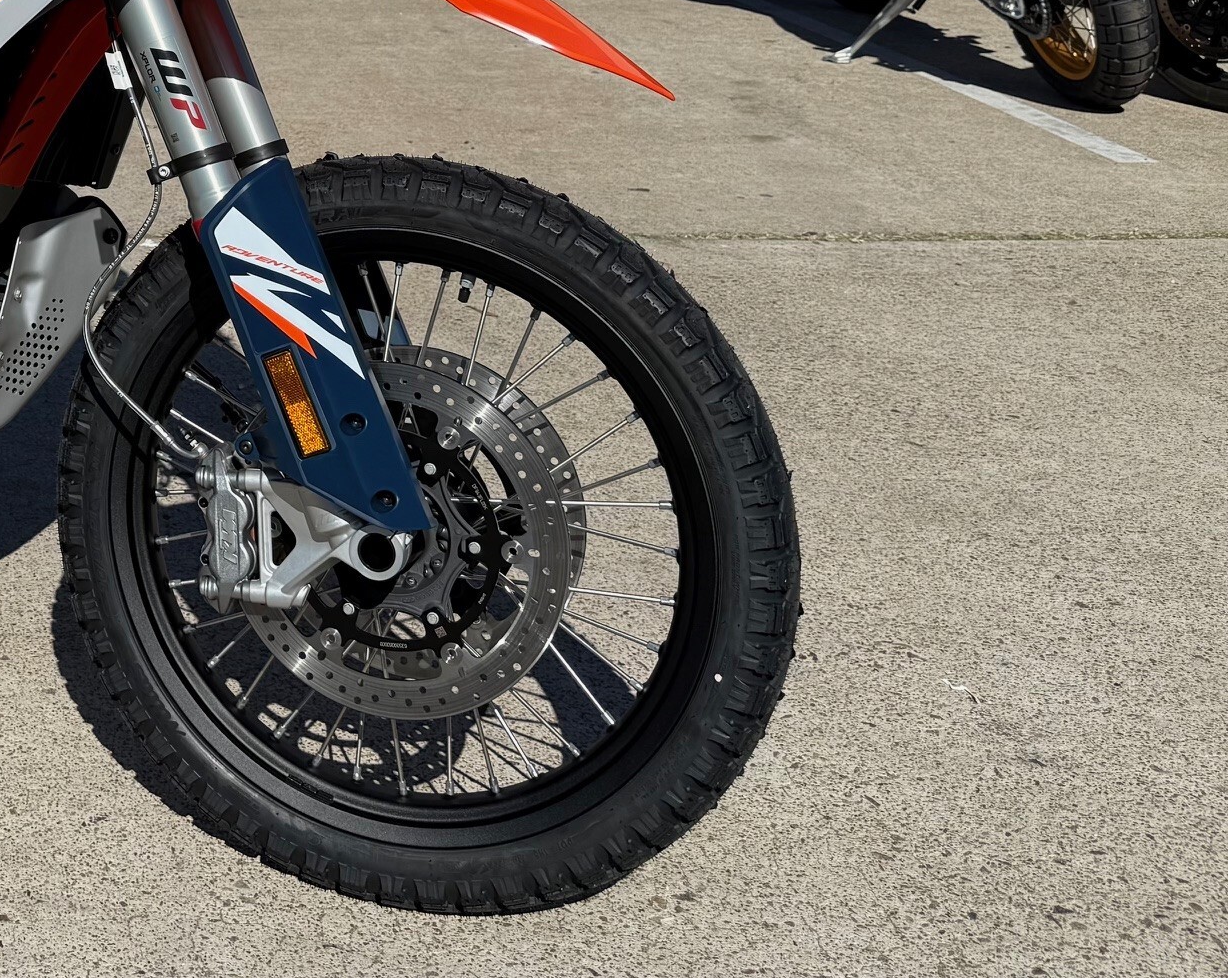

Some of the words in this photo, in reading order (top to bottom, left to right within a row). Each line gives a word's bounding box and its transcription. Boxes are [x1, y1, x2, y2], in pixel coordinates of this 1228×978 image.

[139, 50, 157, 84] XPLOR
[149, 47, 208, 131] WP
[220, 244, 325, 285] ADVENTURE
[217, 508, 239, 566] KTM
